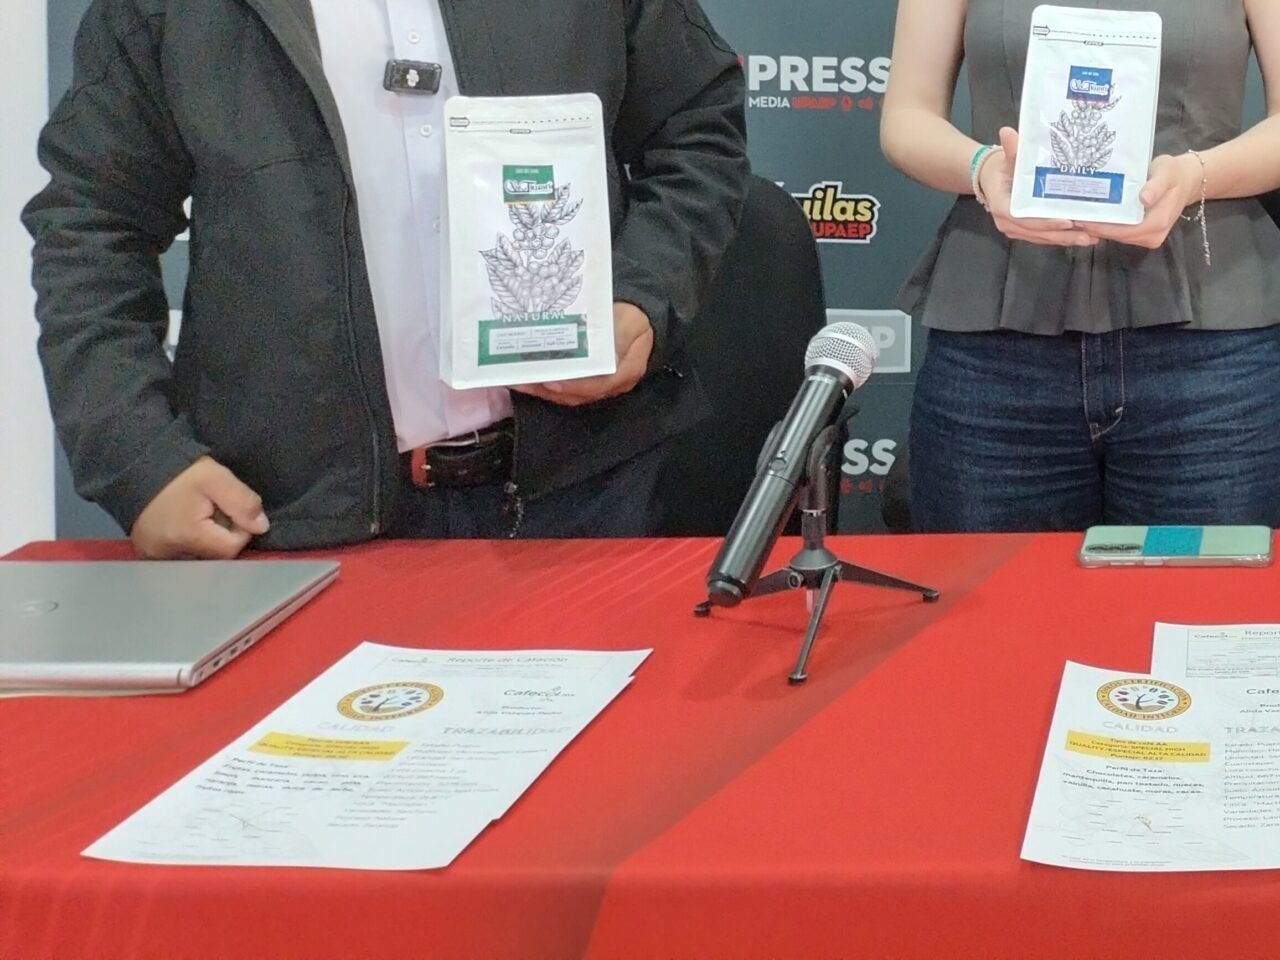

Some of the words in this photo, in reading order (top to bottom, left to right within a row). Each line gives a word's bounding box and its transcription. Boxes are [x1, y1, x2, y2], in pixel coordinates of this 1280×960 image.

[740, 55, 893, 93] PRESS
[749, 96, 790, 108] MEDIA
[1060, 165, 1096, 175] DAILY
[503, 309, 566, 323] NATURAL
[1102, 721, 1178, 734] CALIDAD
